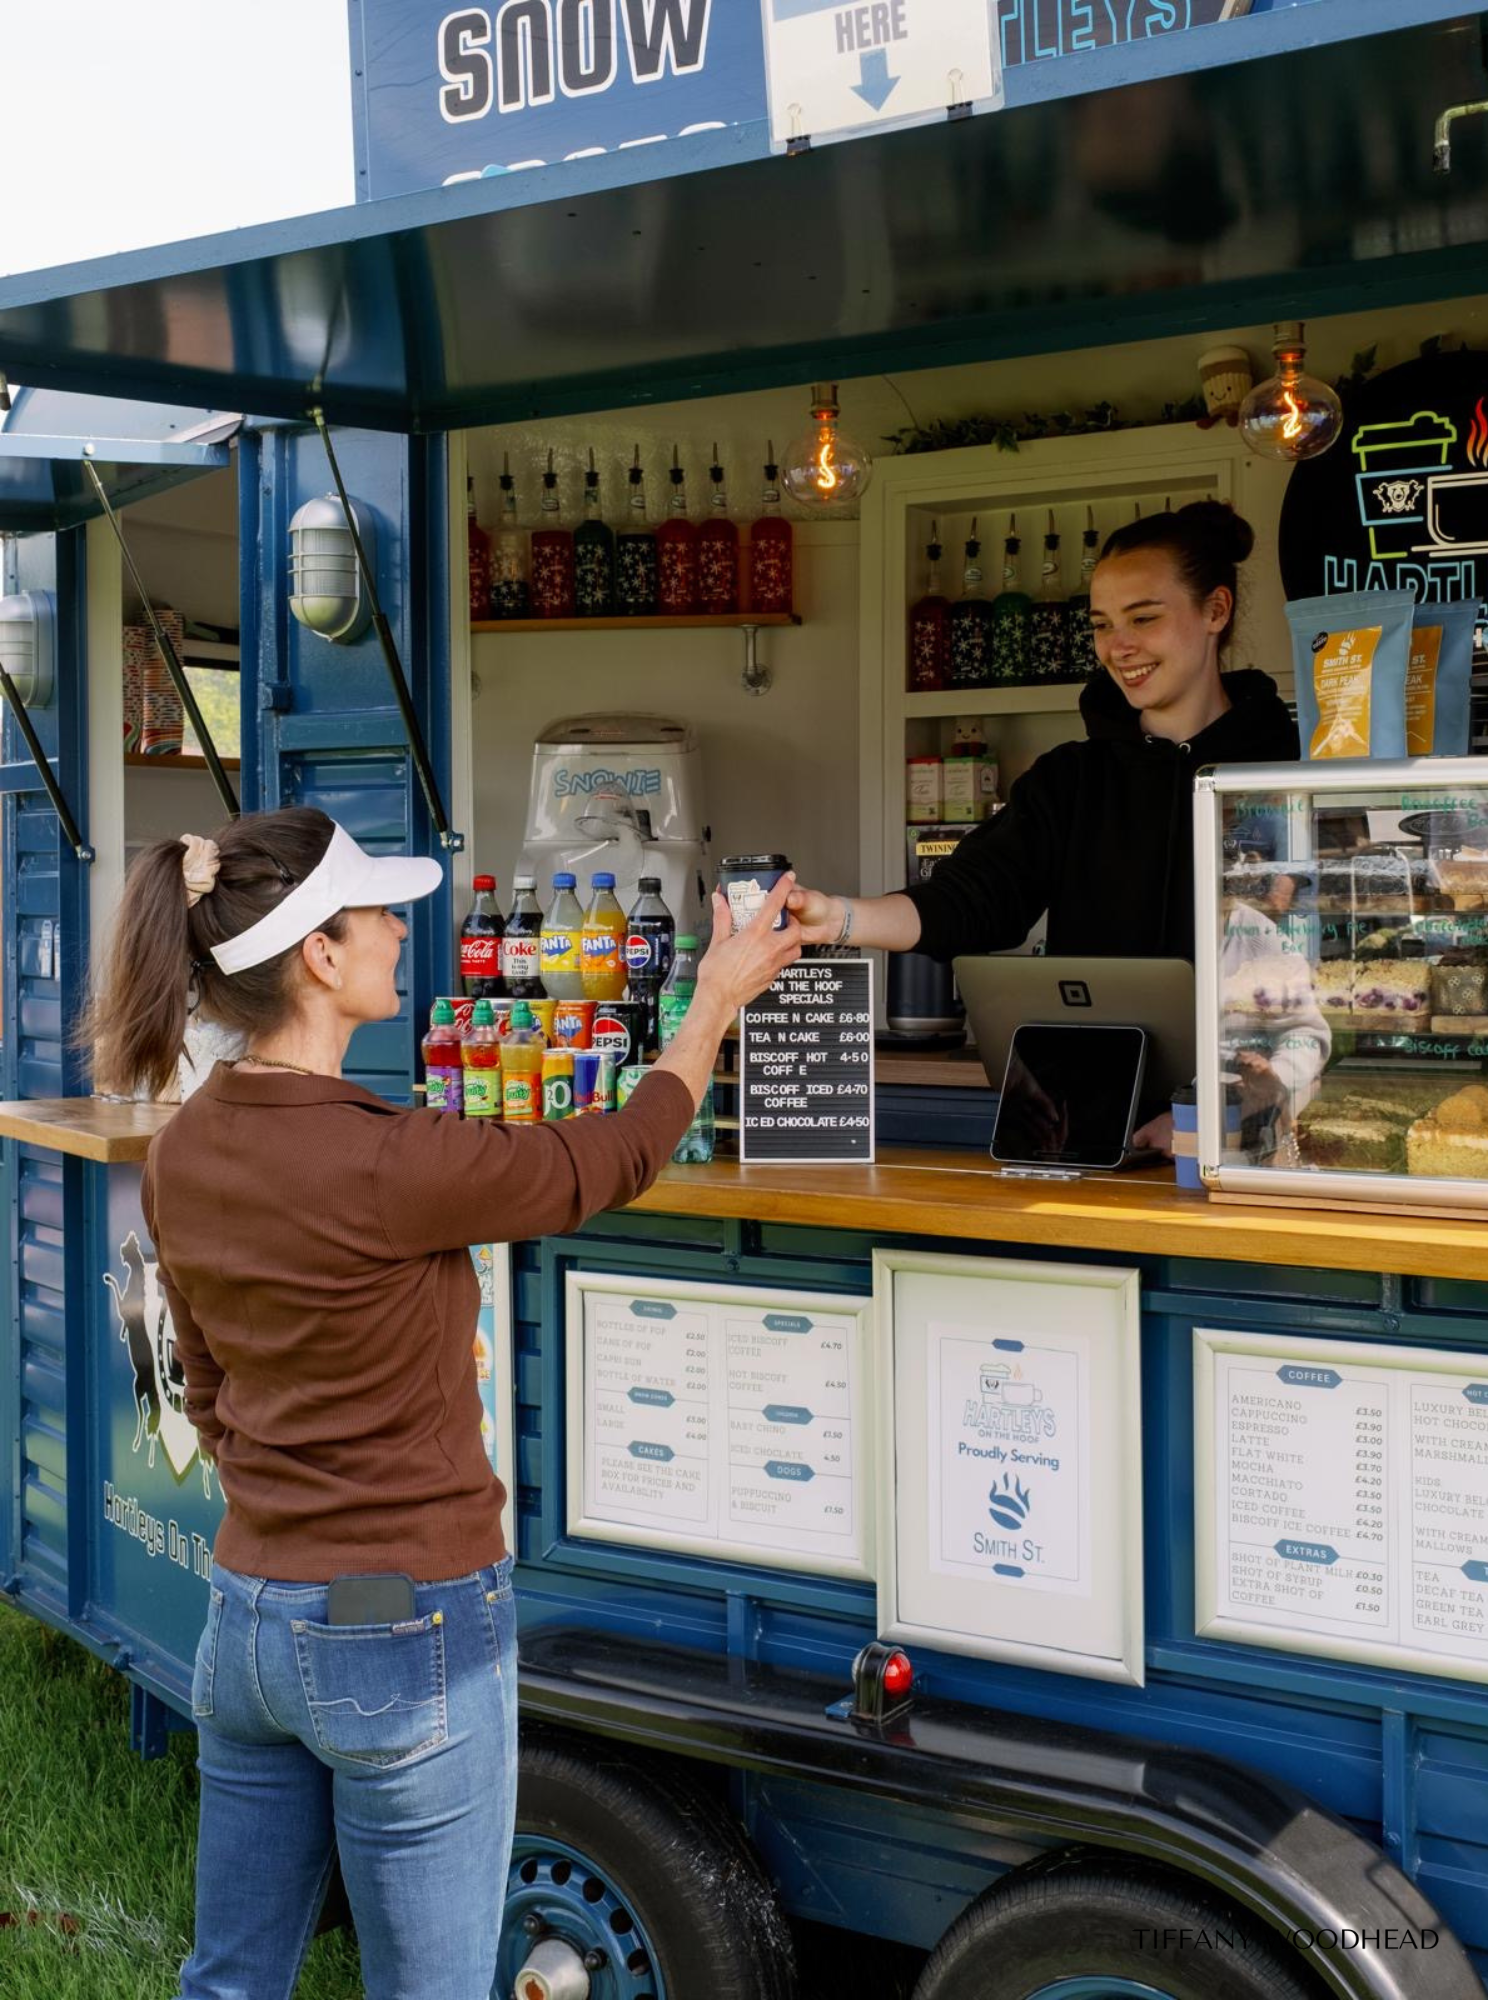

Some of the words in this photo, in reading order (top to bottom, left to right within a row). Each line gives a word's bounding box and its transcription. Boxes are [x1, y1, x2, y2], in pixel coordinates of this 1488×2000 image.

[834, 0, 909, 54] HERE
[437, 0, 713, 124] SNOW
[1406, 675, 1423, 686] EAK
[554, 769, 662, 798] SNOWIE
[921, 844, 955, 854] TWININ
[503, 941, 537, 956] Coke
[540, 935, 571, 950] FANTA
[581, 935, 616, 951] FANTA
[626, 948, 649, 956] PEPSI
[776, 968, 832, 979] HARTLEYS
[770, 980, 784, 992] ON
[790, 980, 810, 992] THE
[814, 980, 843, 992] HOOF
[778, 994, 834, 1005] SPECIALS
[746, 1012, 789, 1024] COFFEE
[792, 1013, 800, 1024] N
[806, 1012, 834, 1024] CAKE
[748, 1032, 772, 1043] TEA
[778, 1032, 786, 1043] N
[790, 1032, 820, 1043] CAKE
[750, 1052, 799, 1063] BISCOFF
[806, 1052, 828, 1063] HOT
[592, 1090, 614, 1102] Bull
[750, 1084, 800, 1095] BISCOFF
[806, 1084, 834, 1095] ICED
[764, 1098, 808, 1109] COFFEE
[776, 1116, 837, 1128] CHOCOLATE
[596, 1320, 634, 1330] BOTTLES
[820, 1341, 843, 1350] £4.70
[1288, 1370, 1331, 1383] COFFEE
[825, 1380, 847, 1390] £4.50
[1231, 1394, 1302, 1410] AMERICANO
[1356, 1406, 1382, 1418] £3.50
[1414, 1401, 1463, 1416] LUXURY
[963, 1400, 1056, 1438] HARTLEYS
[1231, 1408, 1308, 1424] CAPPUCCINO
[1355, 1422, 1382, 1432] £3.90
[1414, 1415, 1439, 1426] HOT
[978, 1430, 992, 1438] ON
[994, 1431, 1010, 1440] THE
[1012, 1434, 1040, 1444] HOOF
[1232, 1420, 1290, 1436] ESPRESSO
[1355, 1435, 1383, 1446] £3.00
[1414, 1434, 1448, 1447] WITH
[638, 1445, 664, 1456] CAKES
[1232, 1434, 1270, 1446] LATTE
[1356, 1450, 1382, 1460] £3.90
[958, 1442, 1008, 1464] Proudly
[1010, 1448, 1060, 1472] Serving
[1232, 1447, 1262, 1458] FLAT
[1265, 1450, 1304, 1464] WHITE
[1356, 1462, 1382, 1473] £3.70
[602, 1457, 634, 1468] PLEASE
[655, 1465, 674, 1476] THE
[776, 1465, 802, 1476] DOGS
[1232, 1460, 1274, 1474] MOCHA
[1355, 1476, 1382, 1486] £4.20
[602, 1469, 620, 1480] BOX
[675, 1481, 696, 1492] AND
[1232, 1473, 1303, 1490] MACCHIATO
[1356, 1490, 1382, 1500] £3.50
[1414, 1476, 1441, 1487] KIDS
[602, 1482, 665, 1499] AVAILABILITY
[1415, 1488, 1461, 1503] LUXURY
[1232, 1486, 1288, 1502] CORTADO
[1356, 1504, 1382, 1514] £3.50
[1232, 1500, 1258, 1512] ICED
[1262, 1504, 1306, 1520] COFFEE
[1356, 1518, 1383, 1529] £4.20
[1415, 1502, 1485, 1519] CHOCOLATE
[104, 1480, 165, 1557] Hartleys
[168, 1519, 189, 1570] On
[191, 1532, 214, 1583] Th
[1232, 1513, 1280, 1528] BISCOFF
[1283, 1520, 1302, 1532] ICE
[1306, 1524, 1351, 1538] COFFEE
[1356, 1530, 1384, 1542] £4.70
[1416, 1526, 1446, 1540] WITH
[1286, 1544, 1328, 1560] EXTRAS
[1416, 1539, 1473, 1555] MALLOWS
[1232, 1552, 1262, 1564] SHOT
[1265, 1556, 1280, 1567] OF
[1284, 1560, 1322, 1574] PLANT
[1324, 1568, 1354, 1578] MILK
[1356, 1570, 1383, 1582] £0.30
[1232, 1565, 1263, 1578] SHOT
[1266, 1570, 1281, 1580] OF
[1286, 1572, 1322, 1588] SYRUP
[1355, 1584, 1383, 1596] £0.50
[1416, 1570, 1440, 1582] TEA
[1232, 1577, 1270, 1591] EXTRA
[1274, 1583, 1306, 1595] SHOT
[1308, 1589, 1324, 1600] OF
[1416, 1584, 1457, 1599] DECAF
[1460, 1590, 1485, 1603] TEA
[1232, 1590, 1276, 1605] COFFEE
[1356, 1602, 1380, 1613] £1.50
[1416, 1598, 1456, 1614] GREEN
[1460, 1605, 1485, 1618] TEA
[1416, 1614, 1448, 1628] EARL
[1452, 1620, 1485, 1633] GREY
